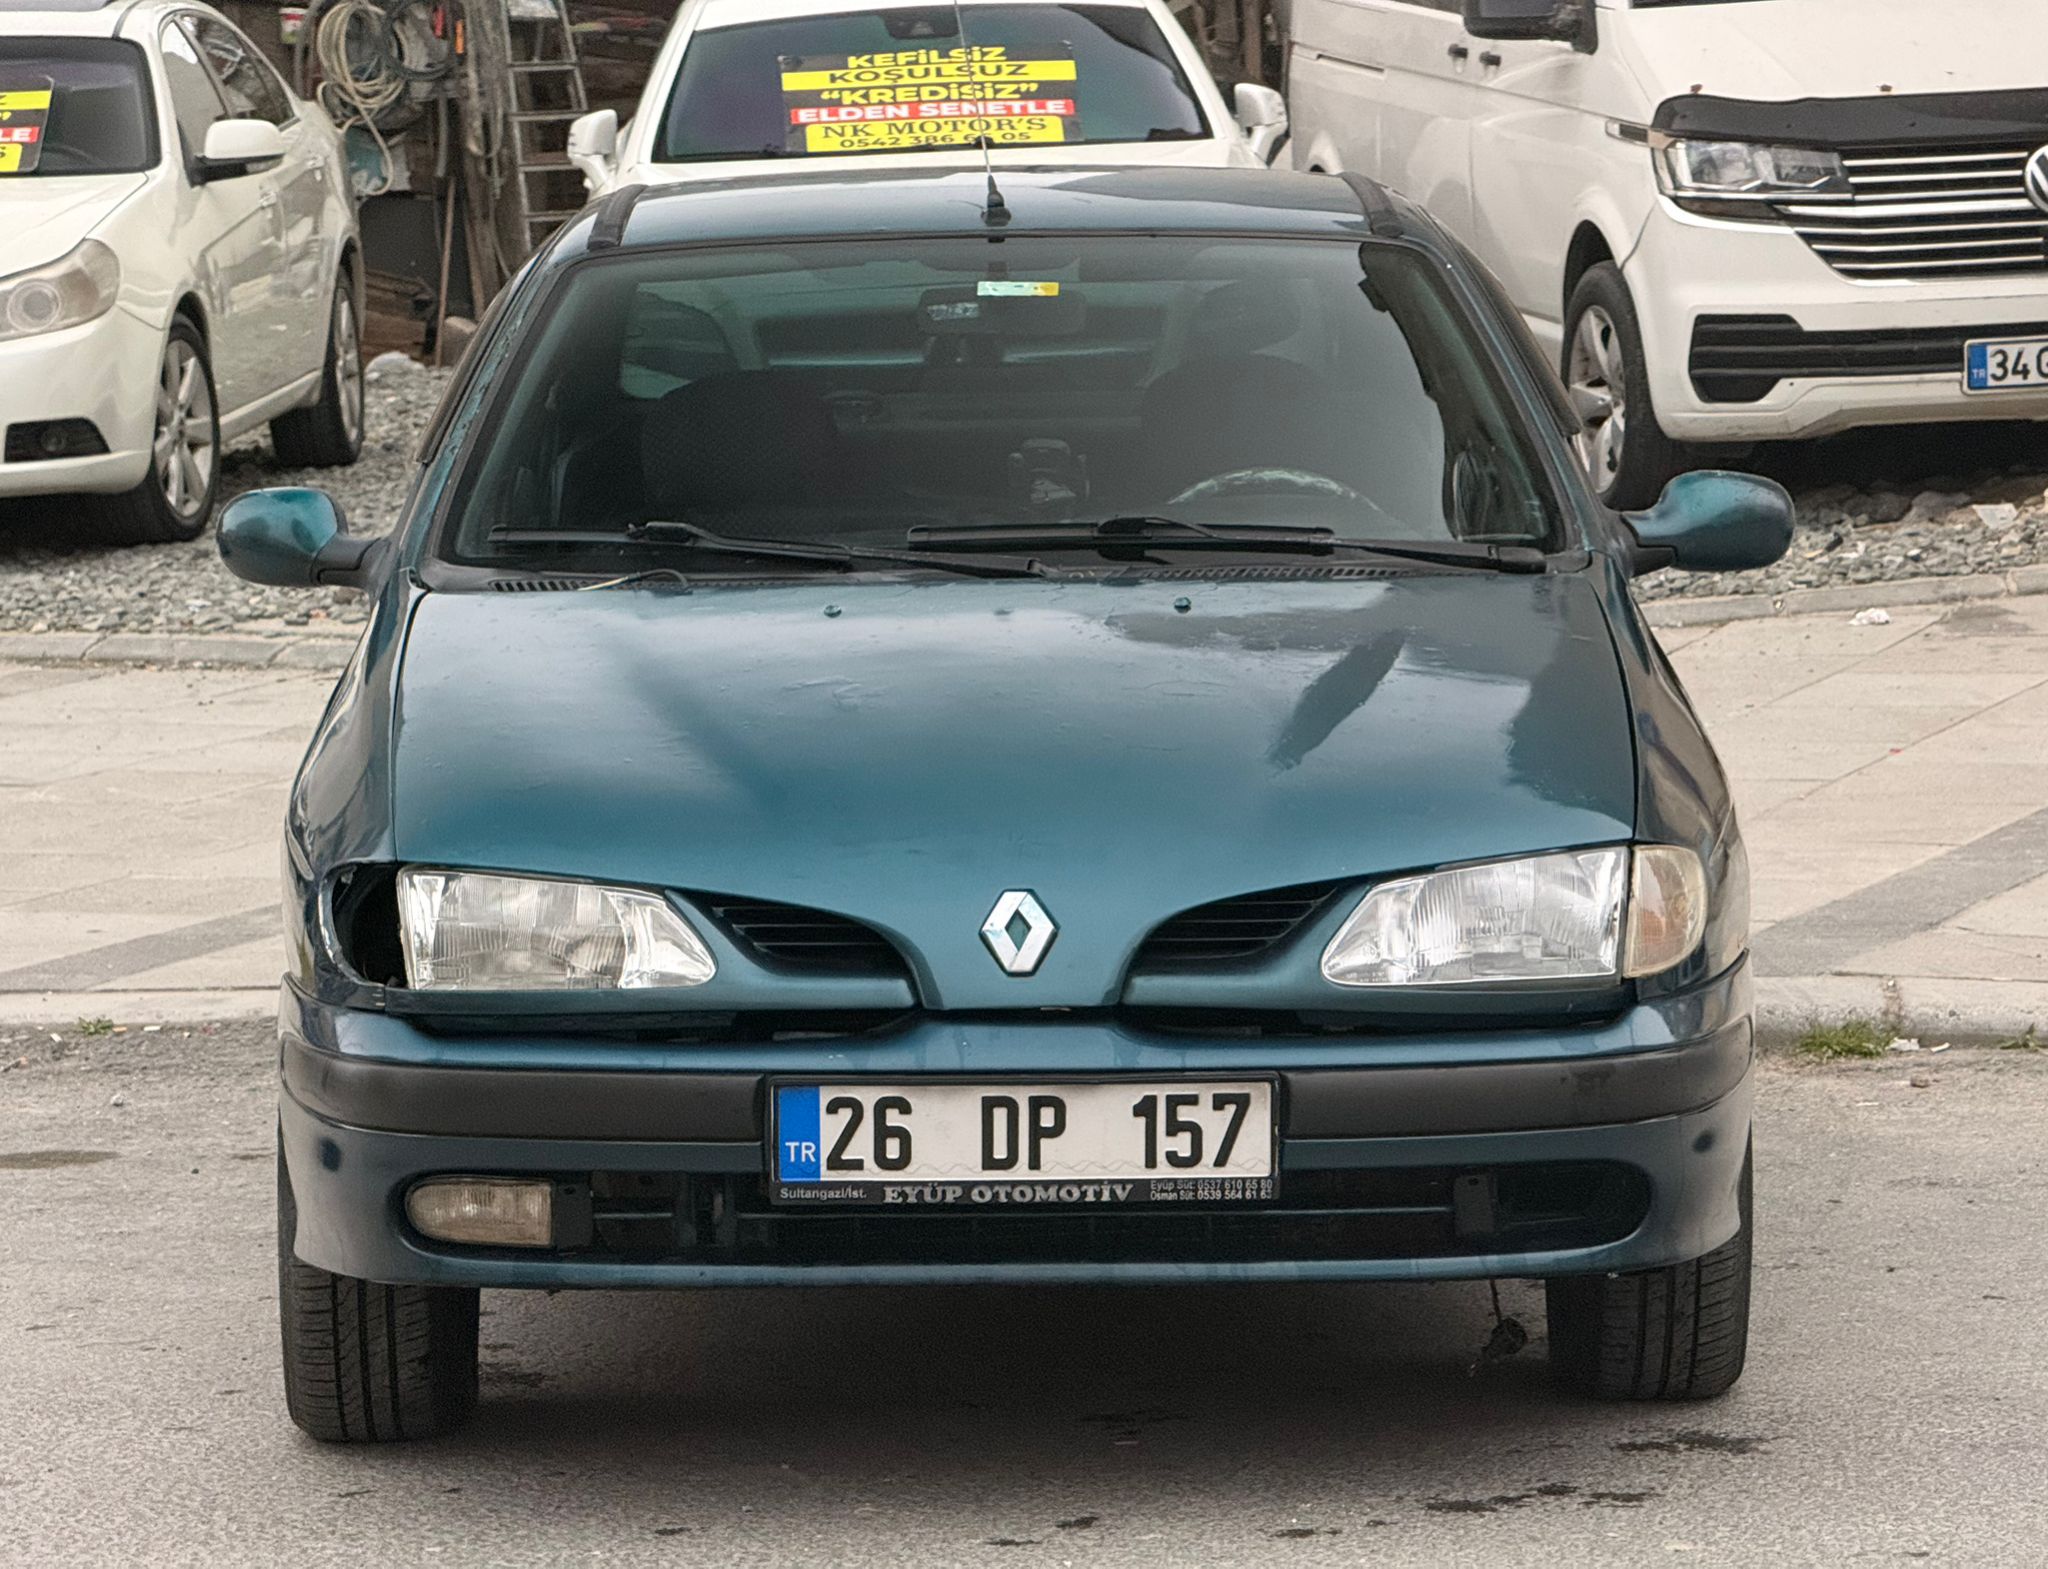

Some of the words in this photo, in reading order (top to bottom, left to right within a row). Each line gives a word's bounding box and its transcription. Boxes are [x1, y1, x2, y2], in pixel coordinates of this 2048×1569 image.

[829, 64, 1029, 84] KOŞULSUZ
[798, 103, 910, 123] ELDEN
[918, 100, 1067, 117] SENETLE
[822, 124, 875, 139] NK
[885, 117, 1047, 135] MOTOR'S
[840, 136, 902, 148] 0542
[910, 134, 954, 144] 386
[1001, 131, 1031, 141] 05
[1972, 368, 1986, 379] TR
[1989, 347, 2030, 382] 34
[825, 1095, 913, 1172] 26
[981, 1094, 1067, 1172] DP
[1132, 1092, 1252, 1169] 157
[785, 1141, 816, 1163] TR
[883, 1182, 963, 1204] EYÜP
[970, 1181, 1133, 1203] OTOMOTİV
[1197, 1179, 1221, 1190] 0537
[1224, 1179, 1243, 1190] 610
[1245, 1179, 1258, 1190] 65
[1197, 1189, 1222, 1200] 0539
